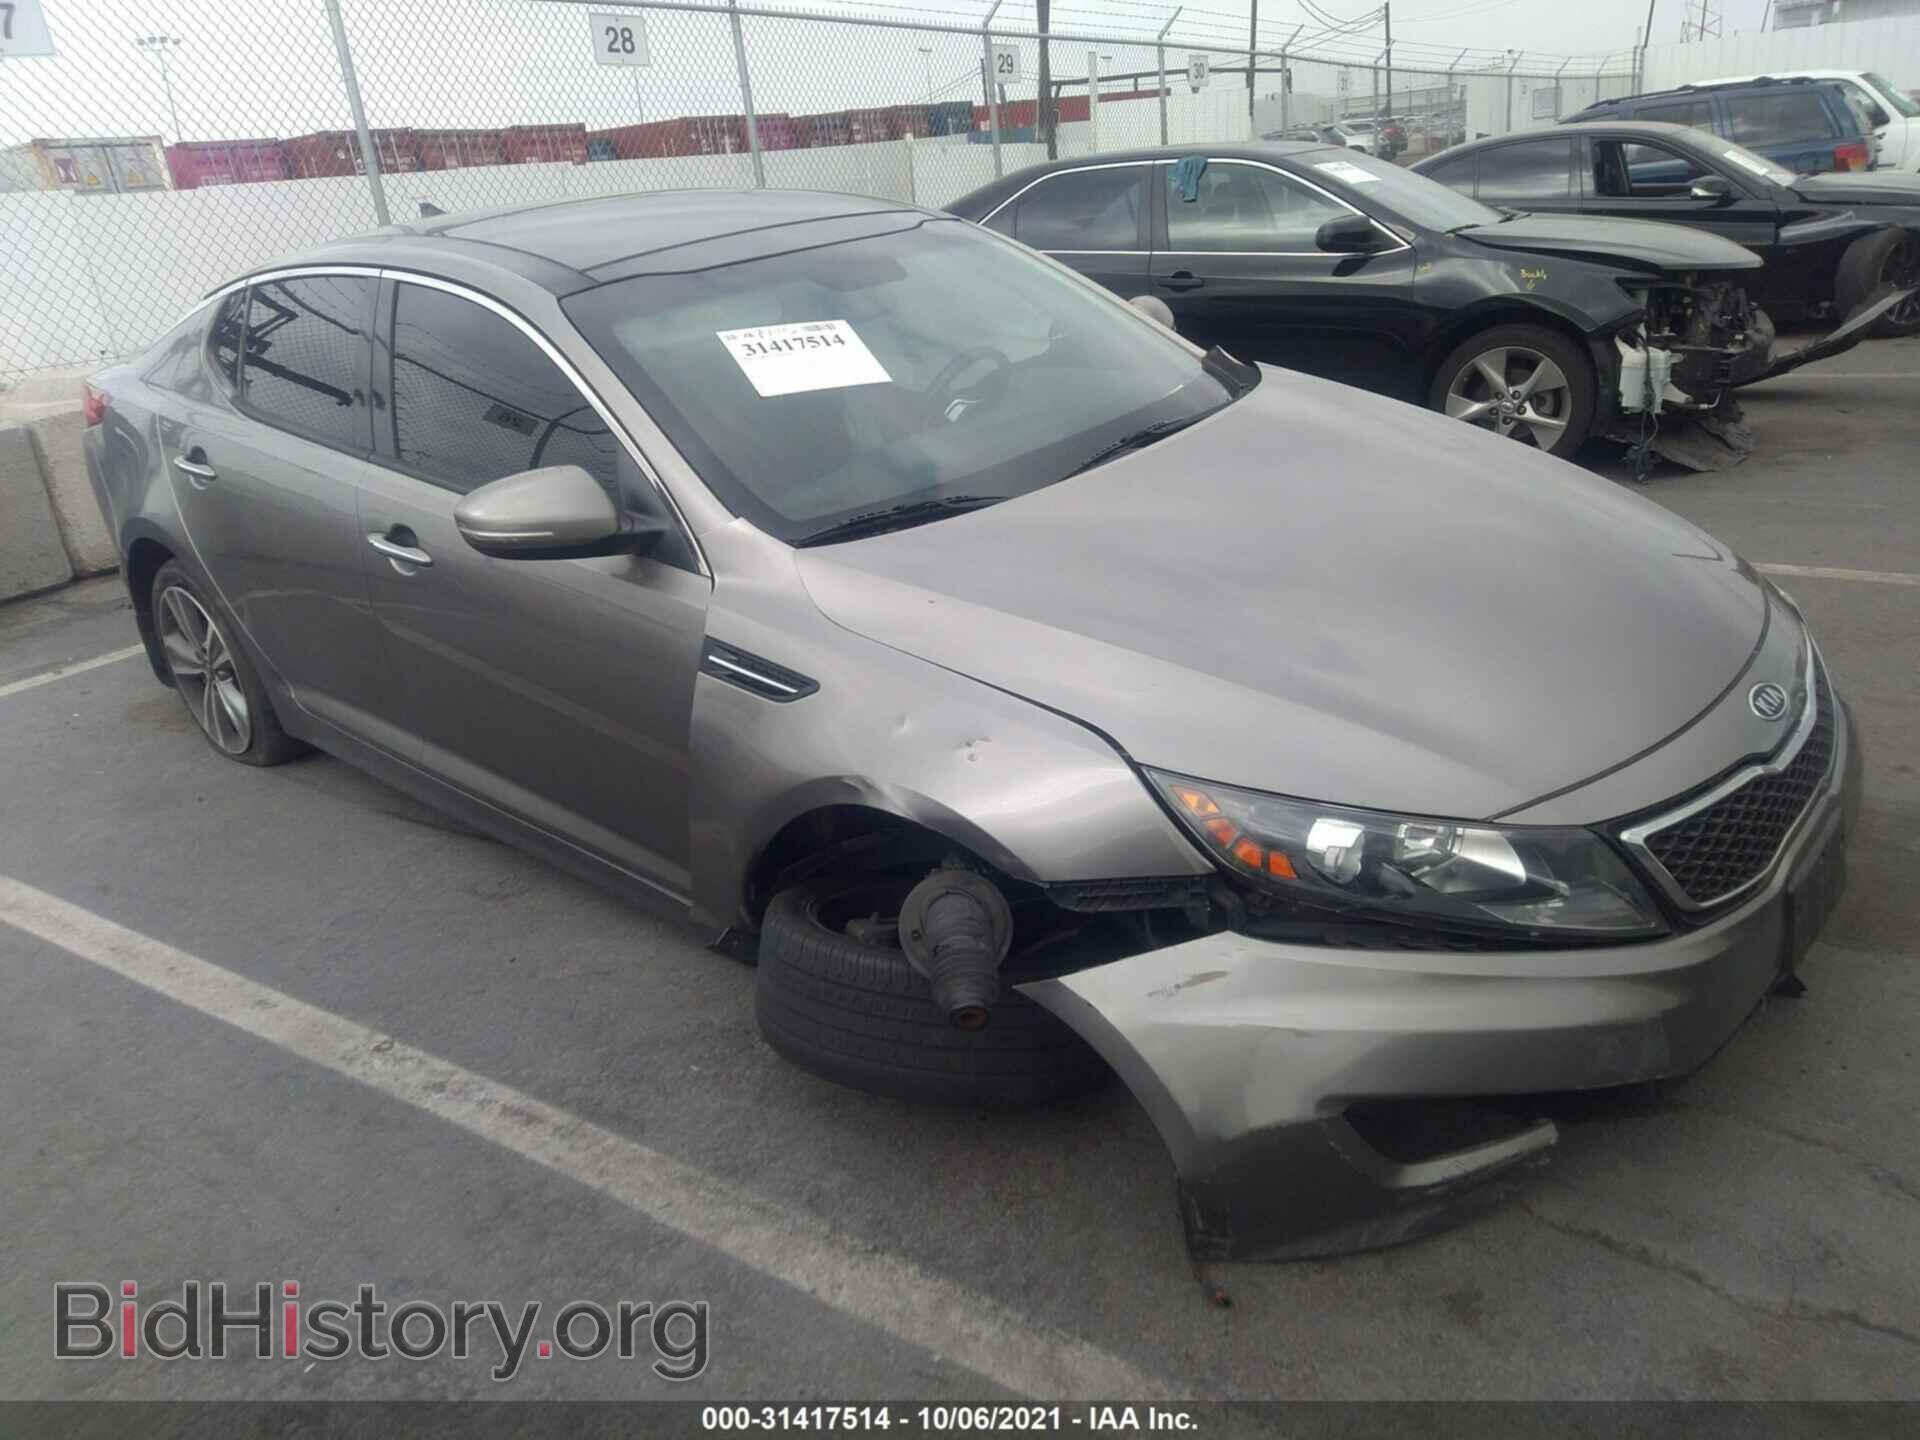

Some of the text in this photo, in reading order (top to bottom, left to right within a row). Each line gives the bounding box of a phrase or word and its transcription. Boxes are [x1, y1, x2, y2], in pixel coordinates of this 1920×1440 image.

[605, 26, 636, 55] 28
[998, 53, 1014, 74] 29
[1193, 62, 1205, 80] 30
[741, 333, 847, 357] 31417514
[1754, 686, 1784, 716] KIA
